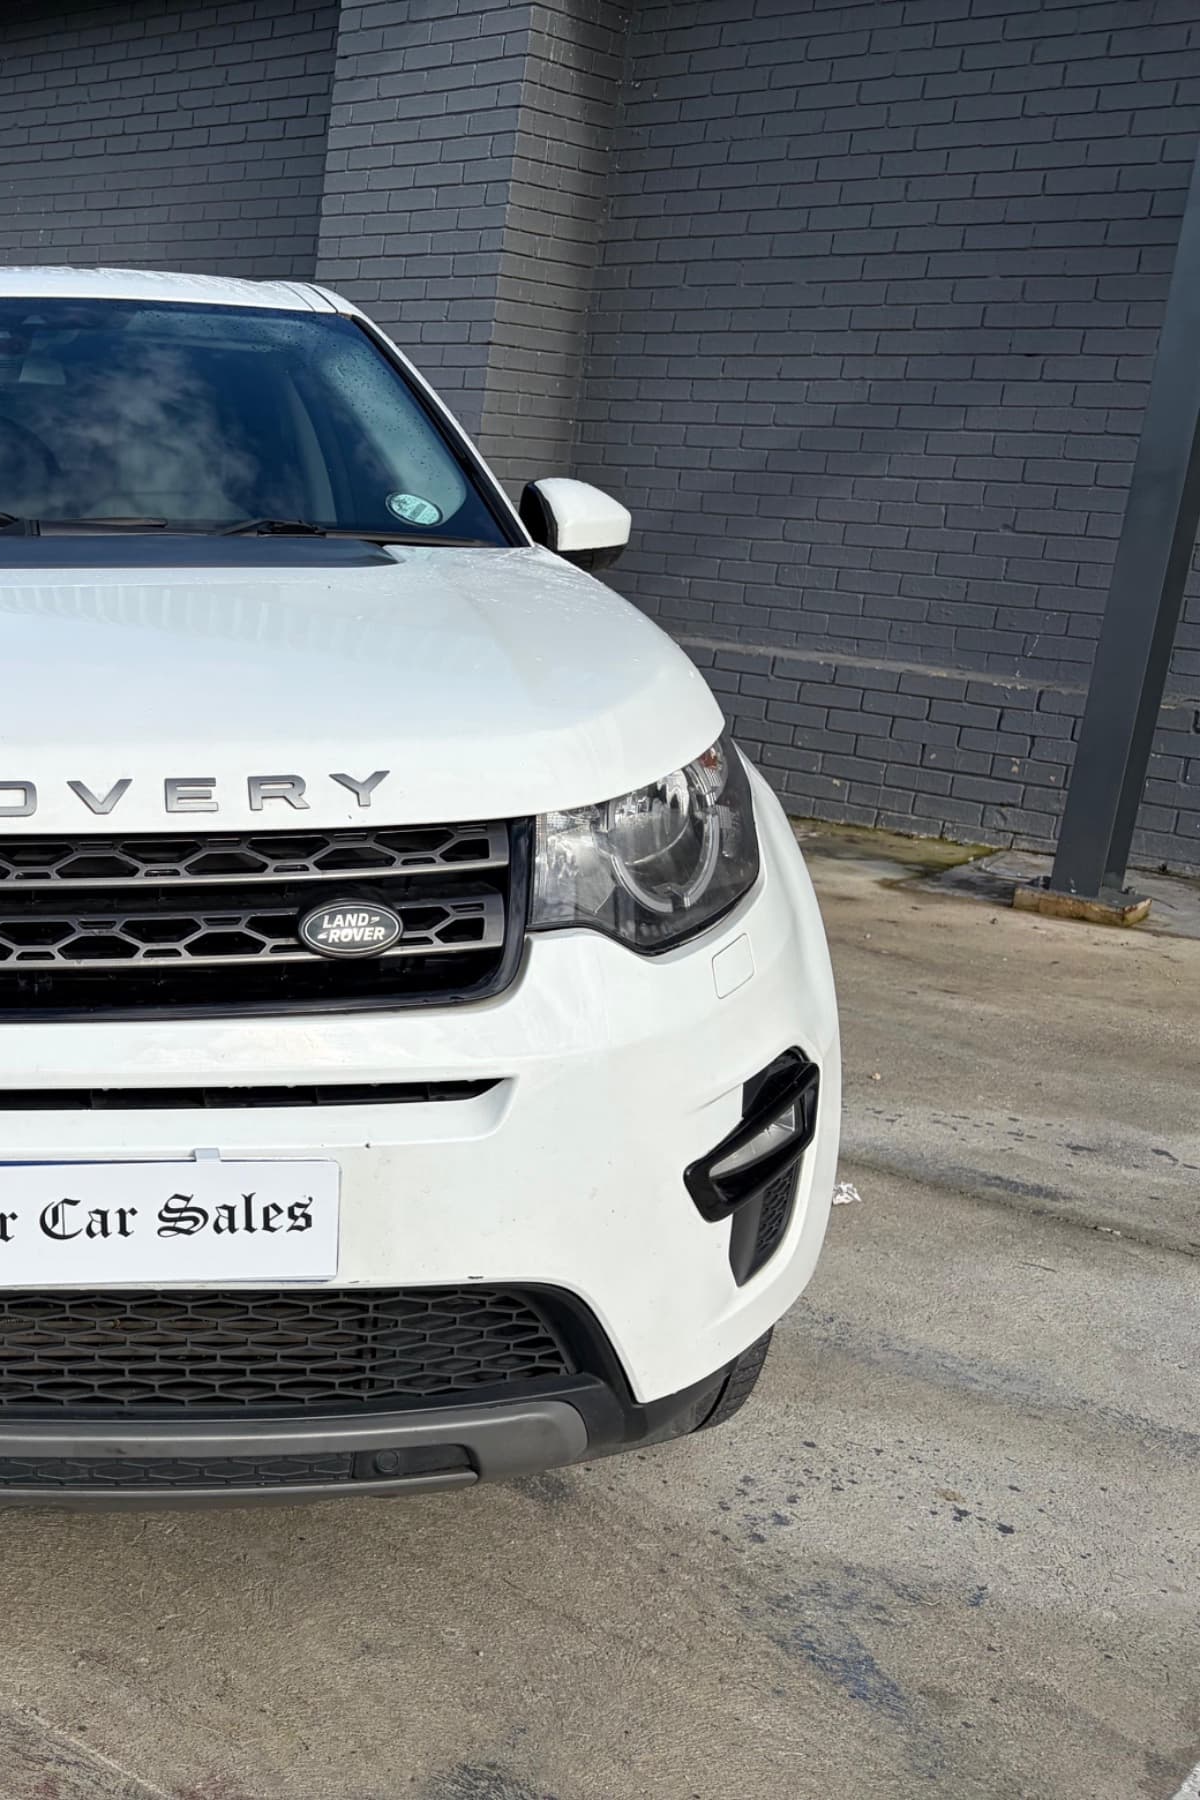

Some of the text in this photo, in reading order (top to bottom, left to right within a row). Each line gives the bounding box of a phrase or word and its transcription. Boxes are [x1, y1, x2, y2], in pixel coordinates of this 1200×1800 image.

[322, 913, 369, 929] LAND
[328, 927, 385, 943] ROVER
[39, 1198, 138, 1241] Car
[156, 1193, 313, 1238] Sales
